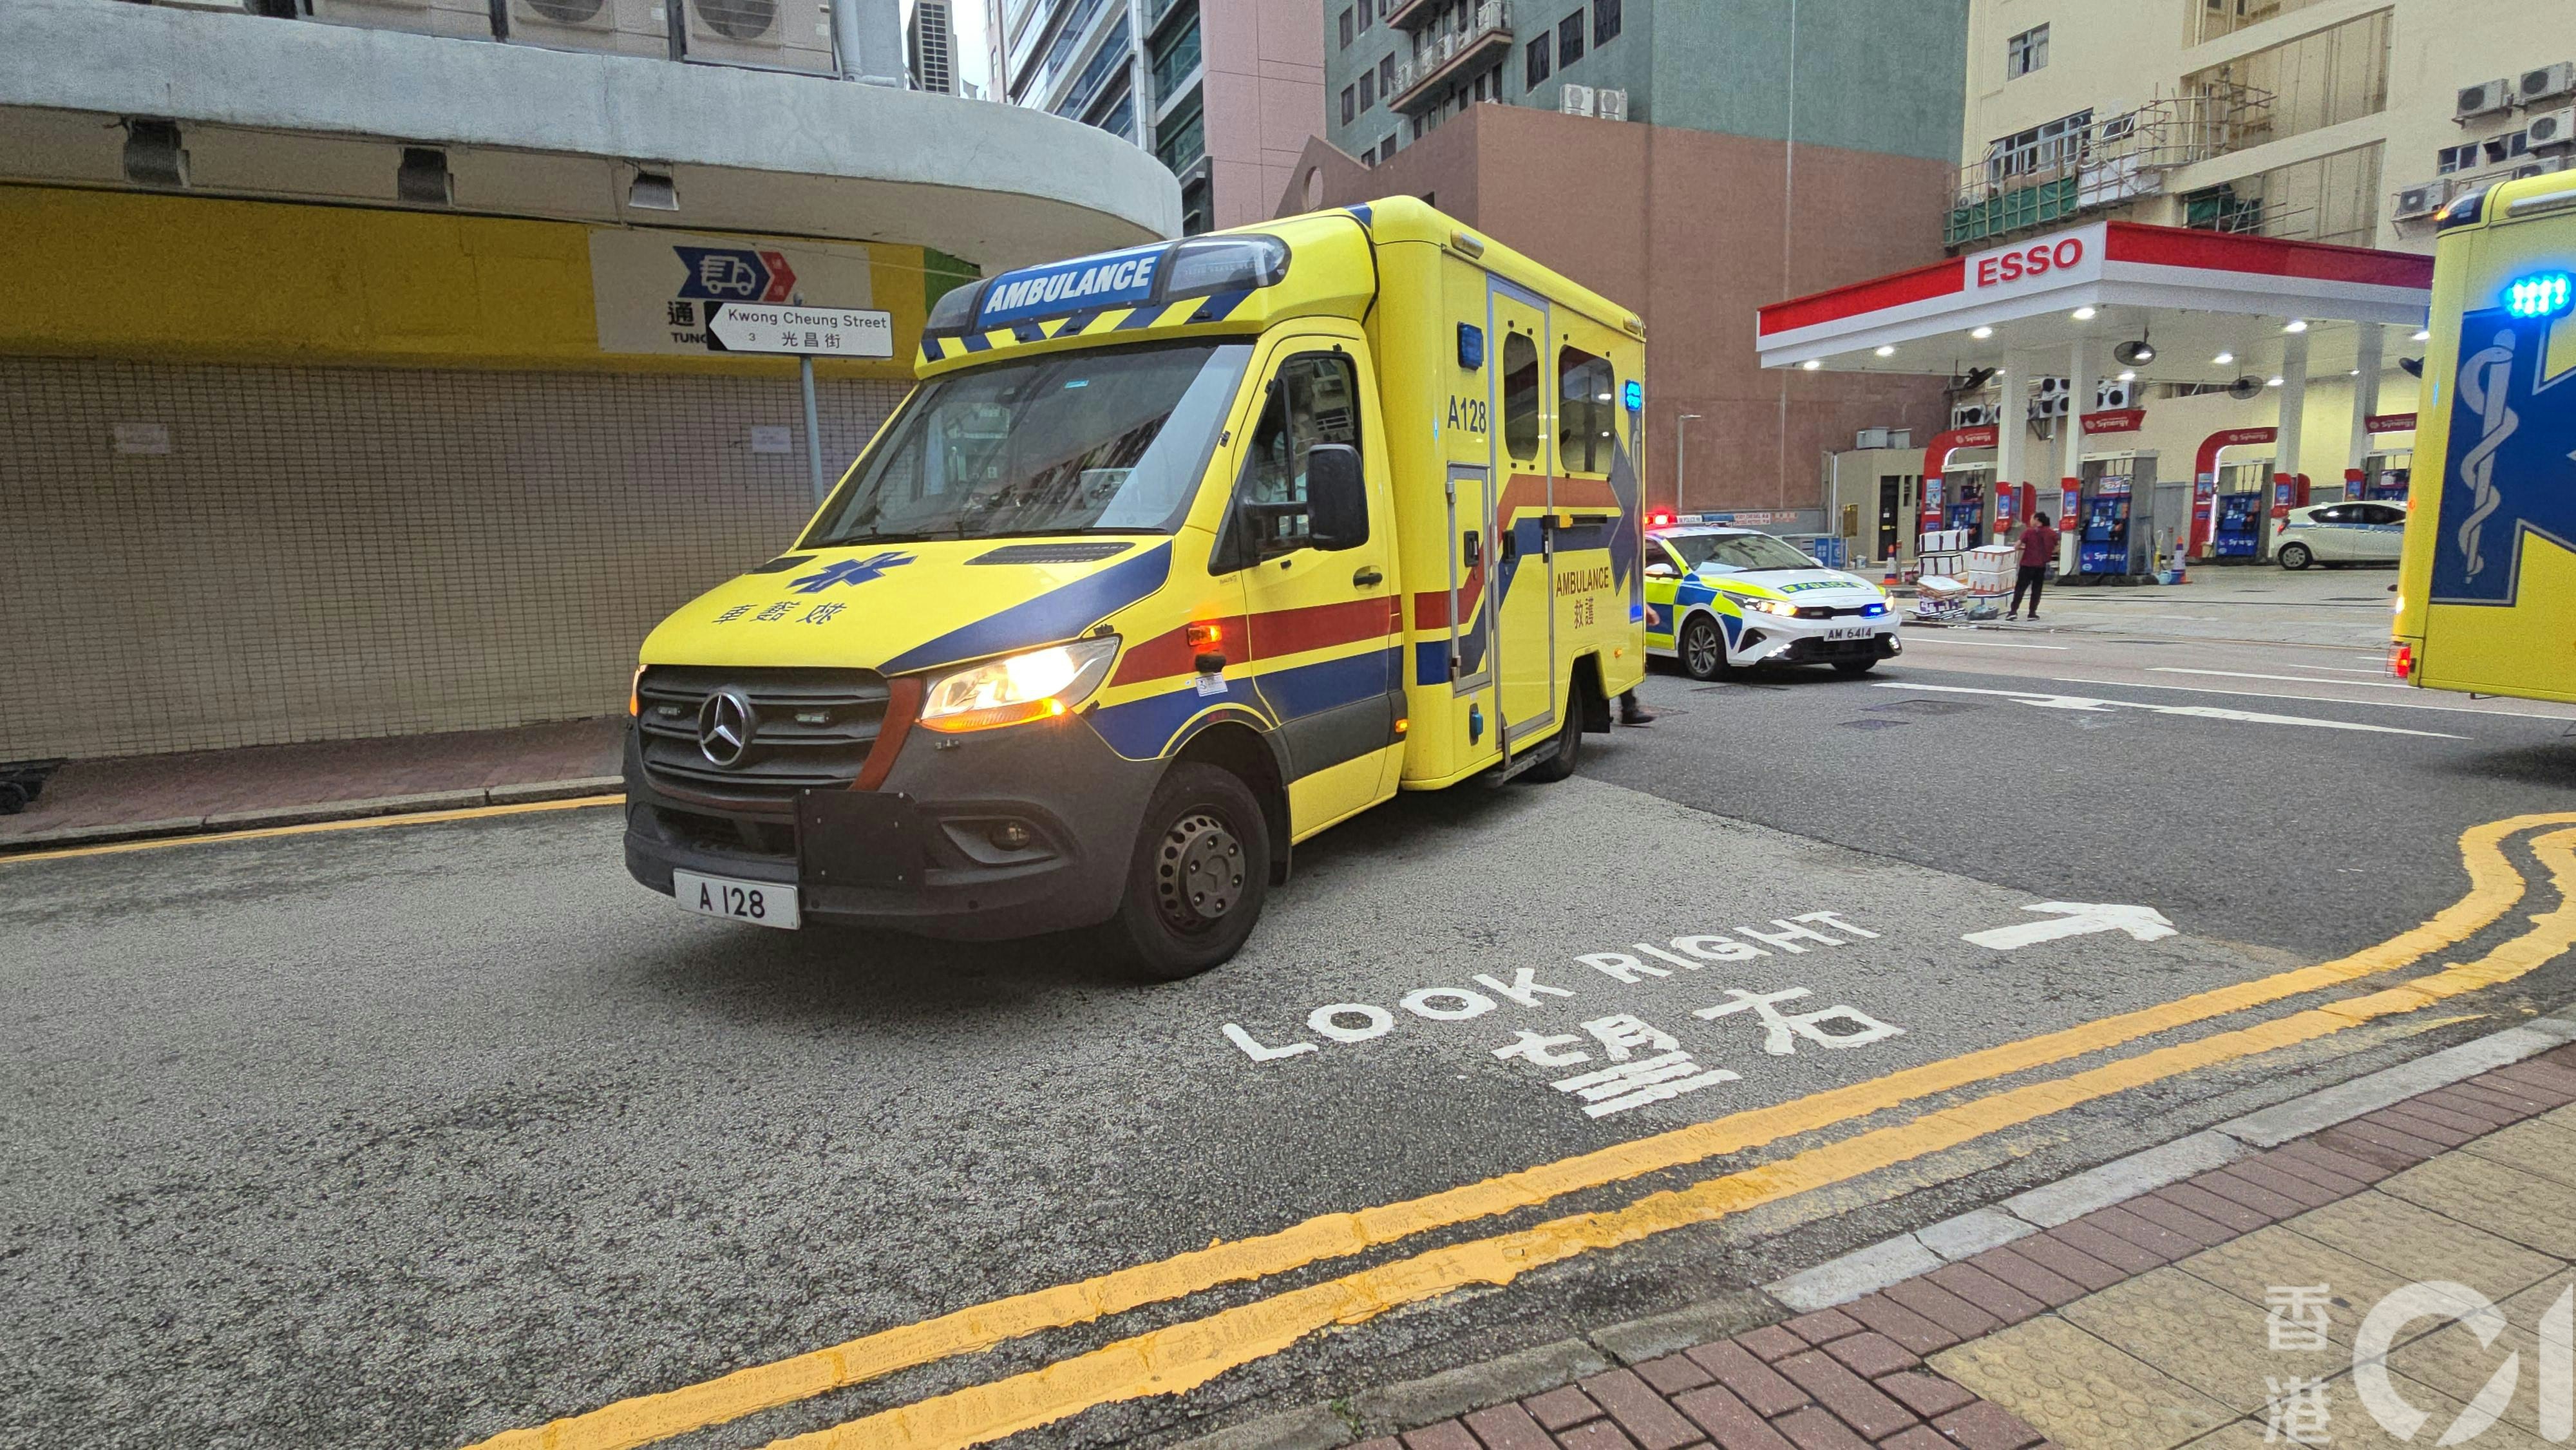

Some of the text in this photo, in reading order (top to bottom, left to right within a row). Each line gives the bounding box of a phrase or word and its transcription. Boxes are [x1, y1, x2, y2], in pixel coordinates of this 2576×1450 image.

[1977, 238, 2084, 288] ESSO
[983, 256, 1157, 314] AMBULANCE
[667, 301, 695, 326] 通
[728, 309, 887, 328] Kwong Cheung Street
[748, 332, 756, 341] 3
[781, 331, 841, 349] 光昌街
[1447, 395, 1487, 435] A128
[1555, 566, 1609, 598] AMBULANCE
[1798, 581, 1850, 590] POLICE
[1573, 596, 1594, 629] 救護
[1827, 627, 1871, 641] AM 6414
[699, 882, 766, 919] A 128
[1222, 910, 1882, 1062] LOOK RIGHT
[1491, 986, 1908, 1119] 望右
